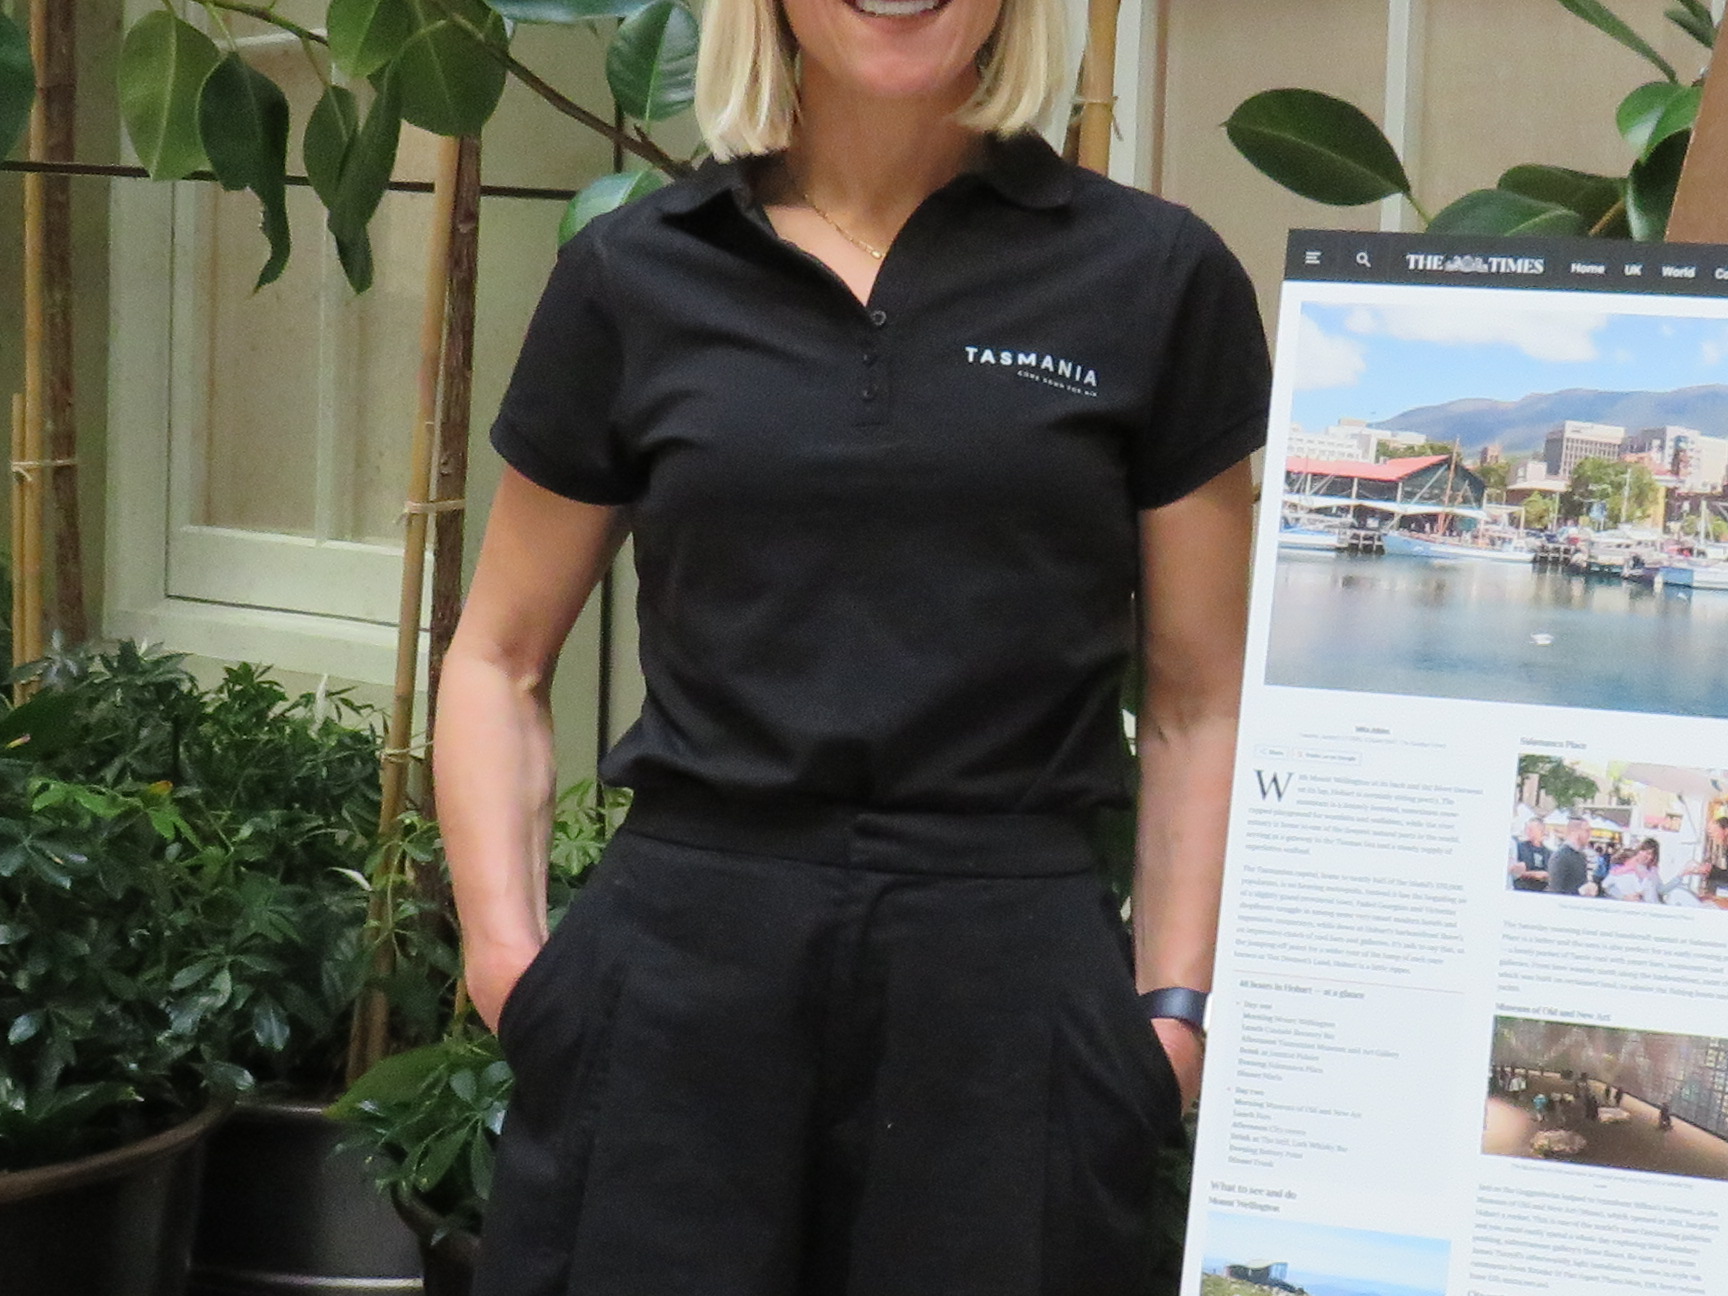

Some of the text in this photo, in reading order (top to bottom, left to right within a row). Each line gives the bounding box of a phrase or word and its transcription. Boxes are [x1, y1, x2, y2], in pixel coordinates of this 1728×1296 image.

[1407, 254, 1544, 274] THE TIMES
[1571, 262, 1605, 275] Home
[1625, 264, 1642, 277] UK
[1662, 265, 1695, 279] World
[964, 346, 1098, 387] TASMANIA
[1254, 769, 1295, 802] W
[1210, 1181, 1236, 1192] What
